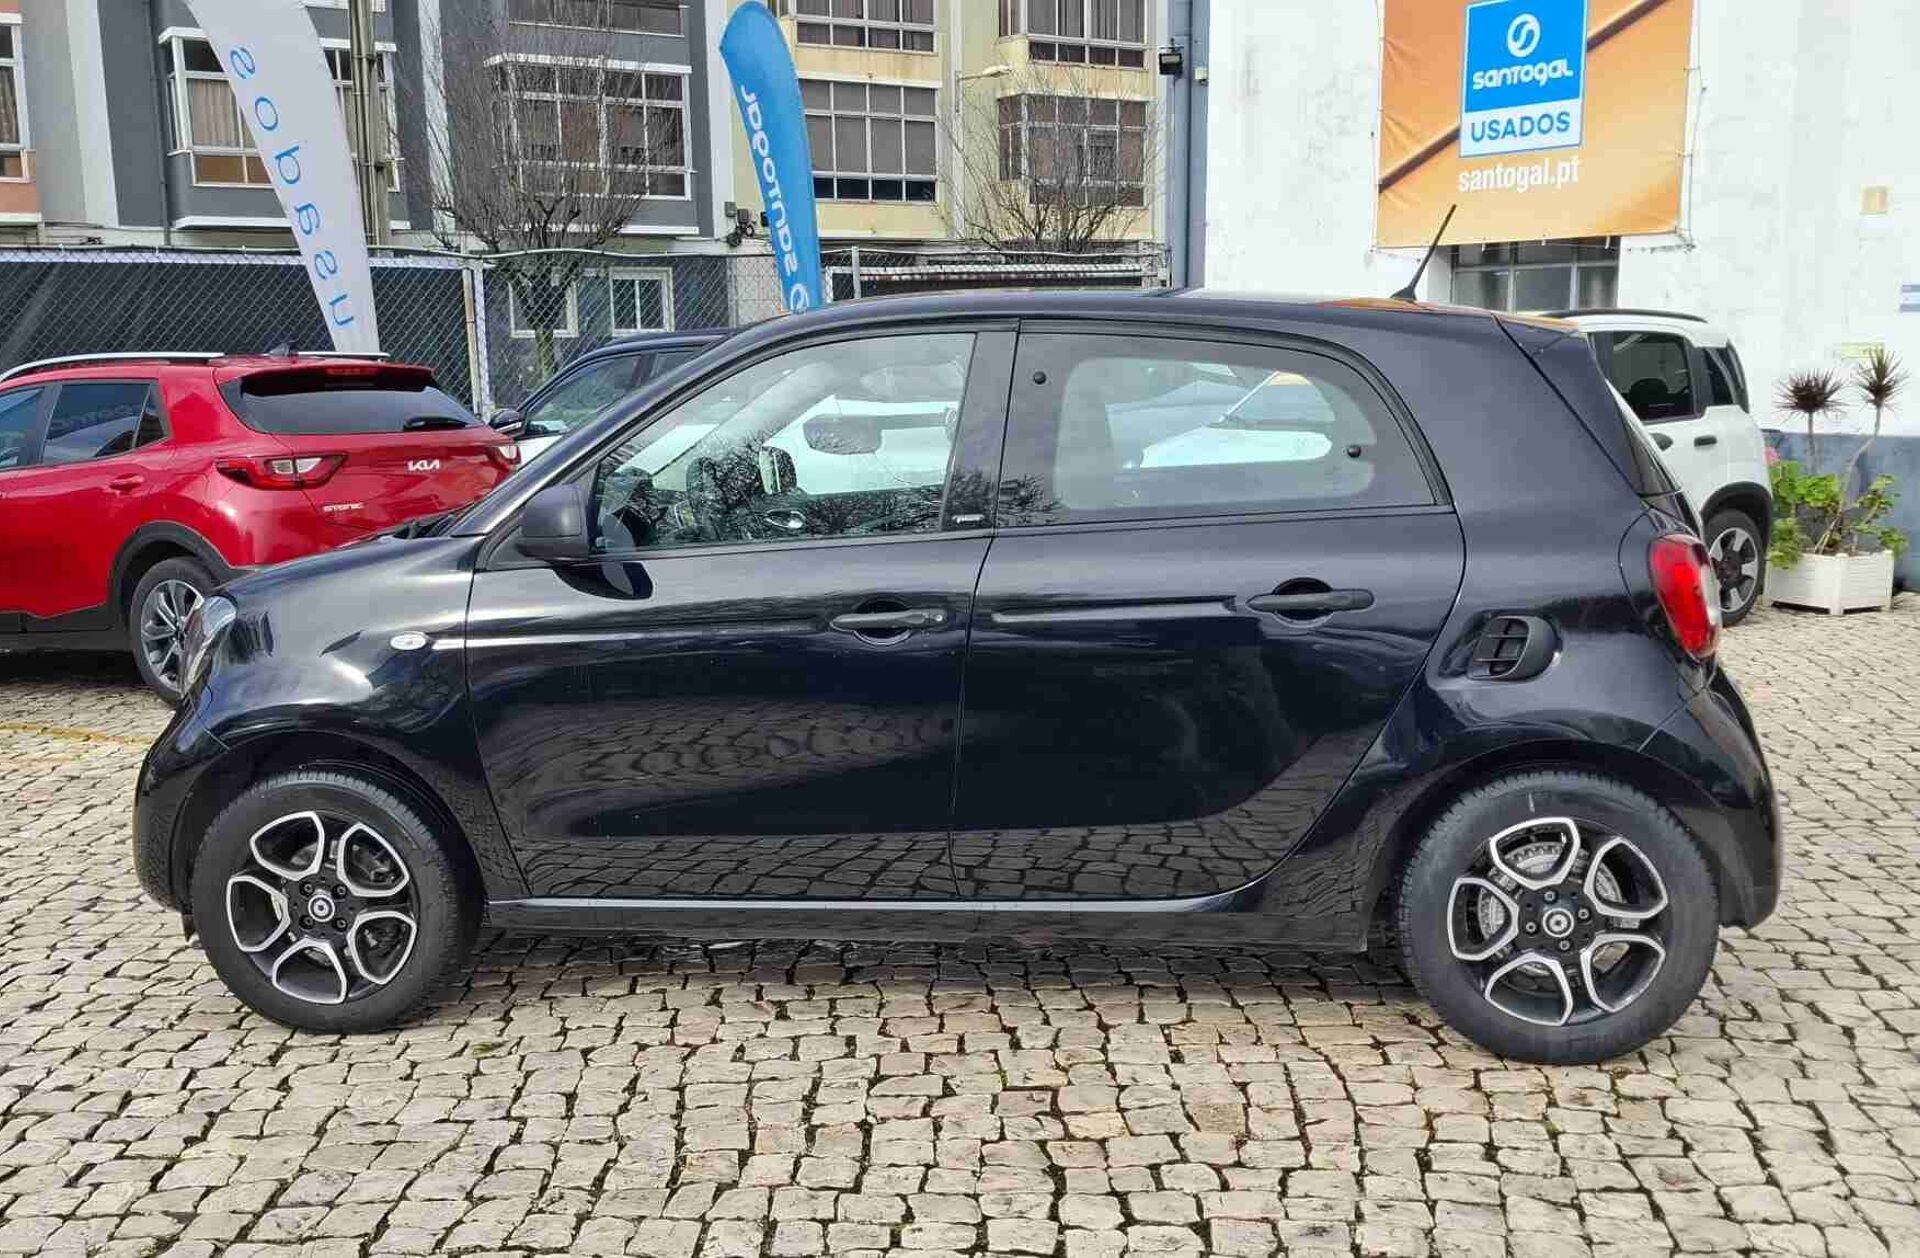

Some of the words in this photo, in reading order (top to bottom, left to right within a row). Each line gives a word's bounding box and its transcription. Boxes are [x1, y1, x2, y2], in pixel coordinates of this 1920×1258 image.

[1471, 111, 1570, 142] USADOS
[1458, 156, 1580, 192] santogal.pt
[407, 459, 440, 471] KIA
